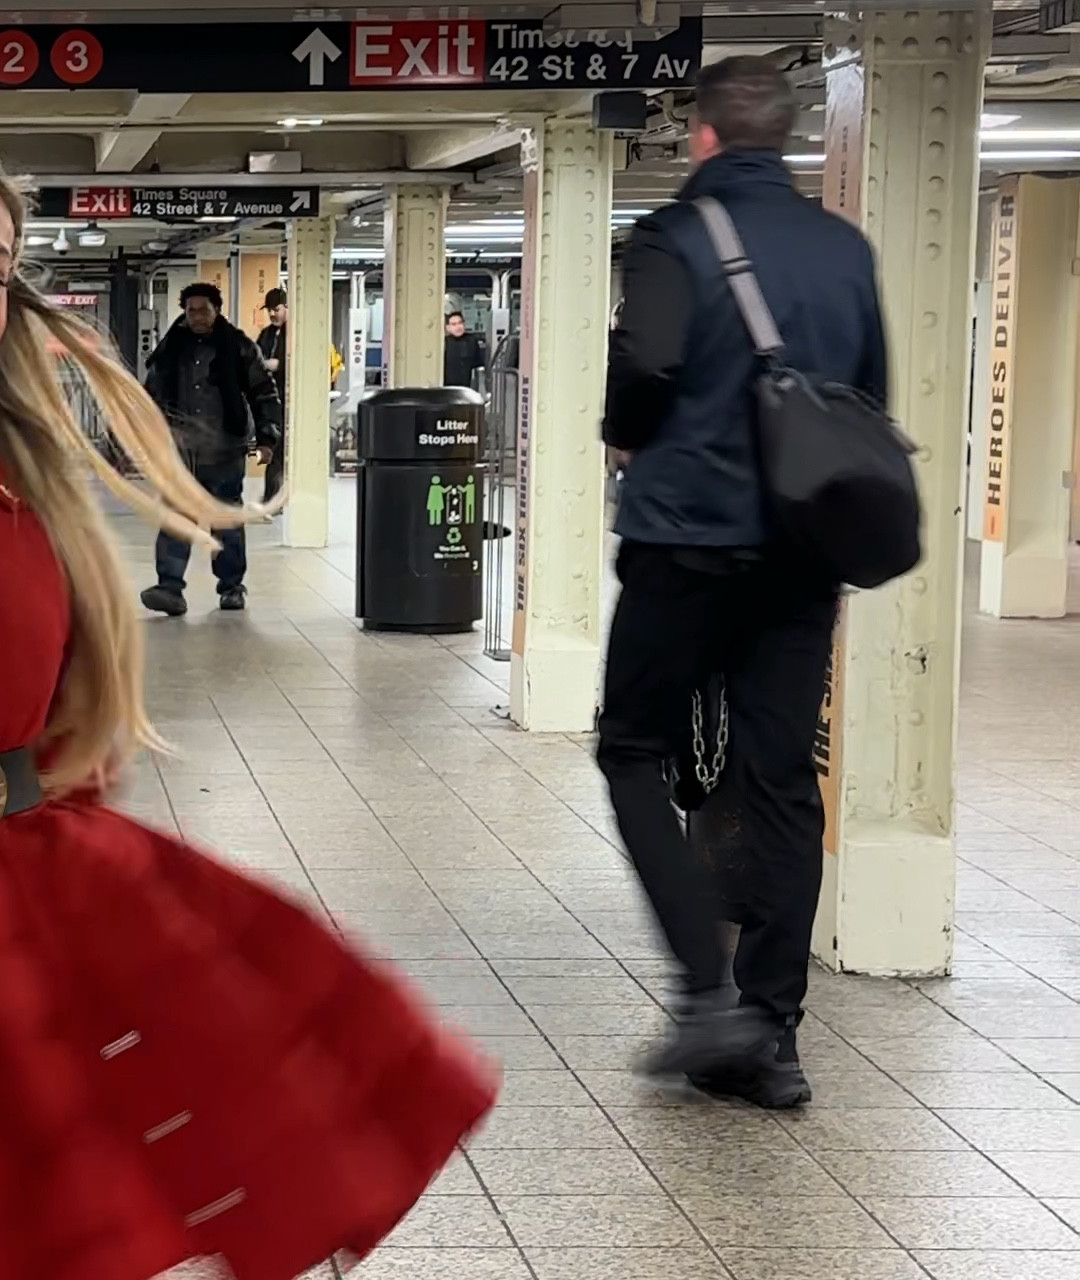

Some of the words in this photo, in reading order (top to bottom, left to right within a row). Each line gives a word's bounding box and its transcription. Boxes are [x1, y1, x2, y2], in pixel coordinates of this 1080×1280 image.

[2, 41, 26, 74] 2
[64, 40, 89, 73] 3
[354, 24, 475, 77] Exit
[489, 55, 529, 81] 42
[541, 54, 576, 81] St
[586, 53, 607, 81] &
[621, 54, 640, 80] 7
[652, 55, 691, 79] Av
[71, 187, 128, 212] Exit
[133, 188, 174, 201] Times
[179, 188, 228, 202] Square
[132, 202, 151, 215] 42
[156, 202, 199, 215] Street
[203, 202, 214, 215] &
[219, 202, 229, 215] 7
[233, 202, 284, 215] Avenue
[994, 195, 1015, 348] DELIVER
[436, 419, 469, 431] Litter
[987, 360, 1008, 506] HEROES
[418, 433, 455, 447] Stops
[456, 433, 479, 445] Here
